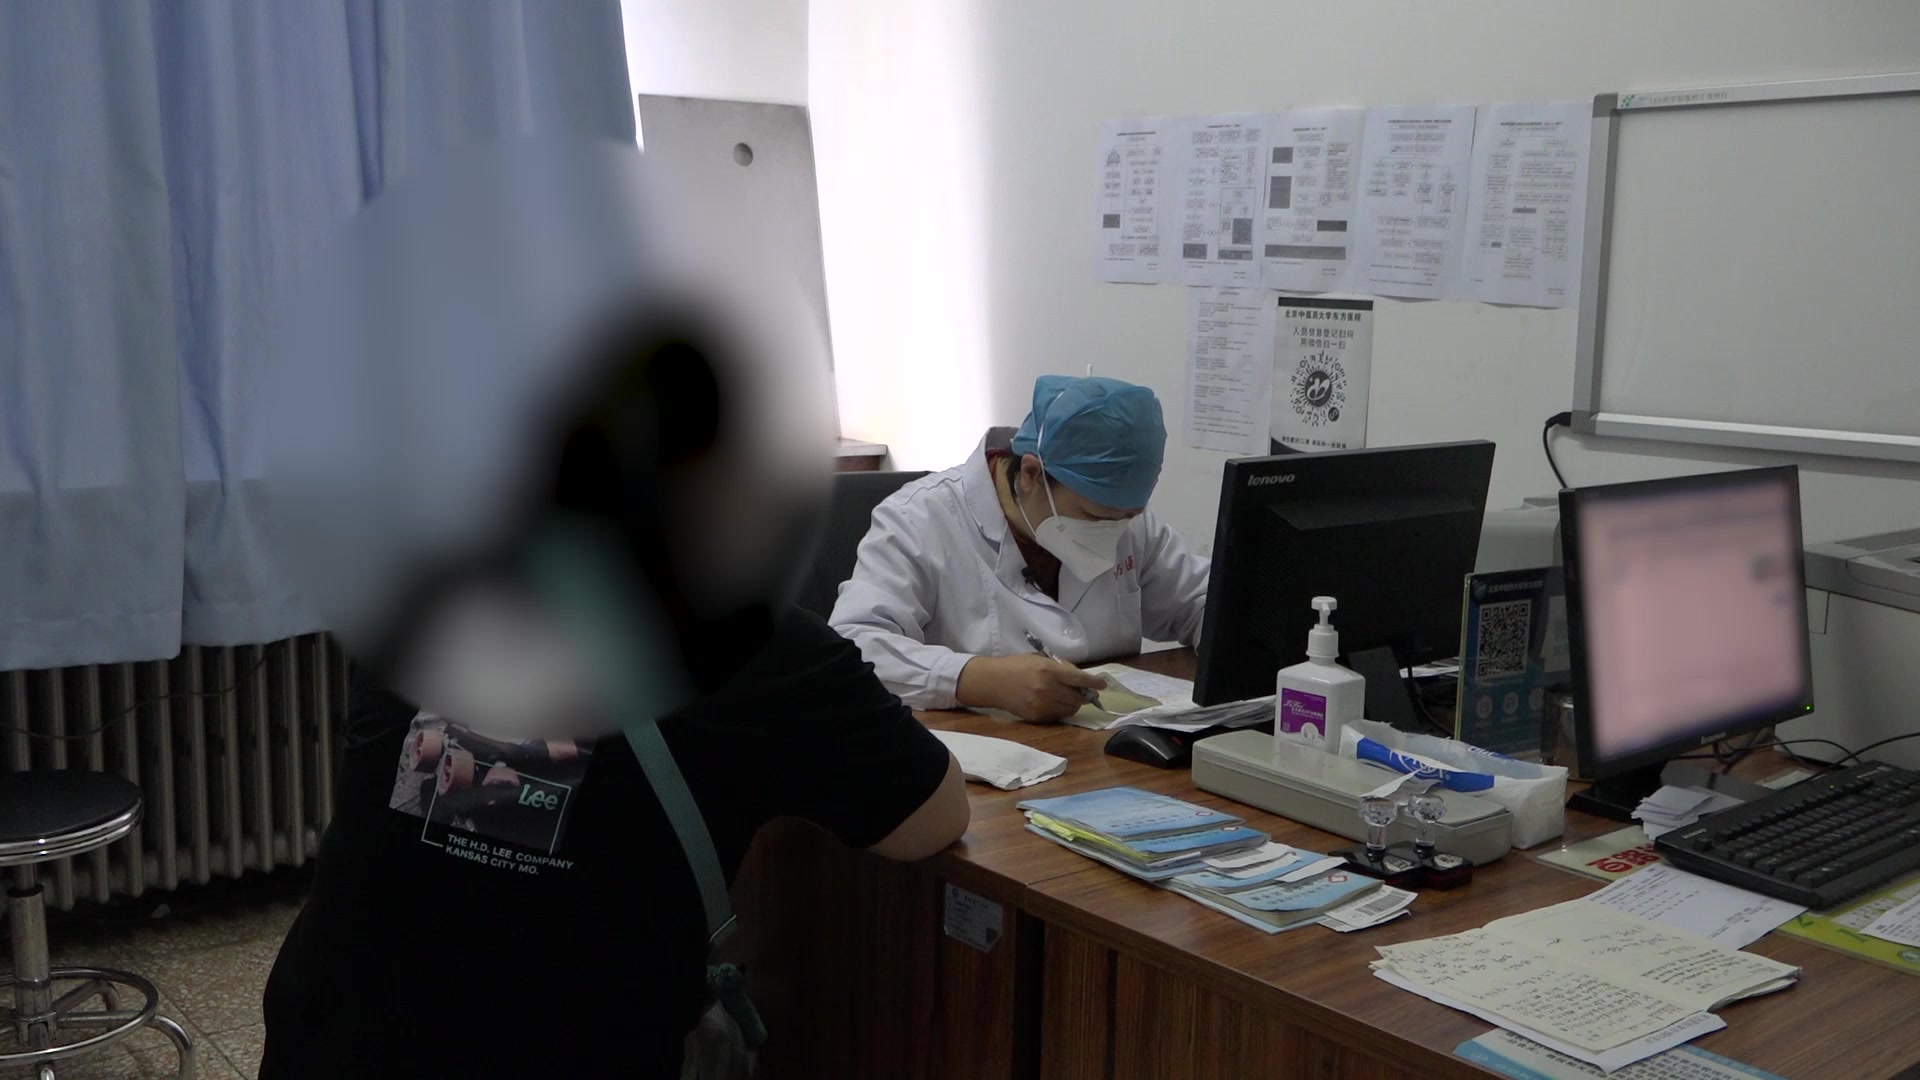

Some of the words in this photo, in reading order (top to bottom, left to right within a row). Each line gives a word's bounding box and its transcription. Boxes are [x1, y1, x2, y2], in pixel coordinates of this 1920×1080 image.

[1284, 309, 1362, 322] 北京中医药大学东方医院
[1293, 326, 1354, 339] 人员信息登记扫码
[1300, 337, 1346, 350] 用微信扫一扫
[1247, 474, 1296, 487] lenovo
[517, 783, 558, 810] Lee
[447, 834, 469, 848] THE
[469, 838, 490, 853] H.D.
[492, 847, 512, 859] LEE
[515, 852, 574, 870] COMPANY
[445, 845, 488, 864] KANSAS
[490, 857, 515, 870] CITY
[518, 863, 540, 875] MO.
